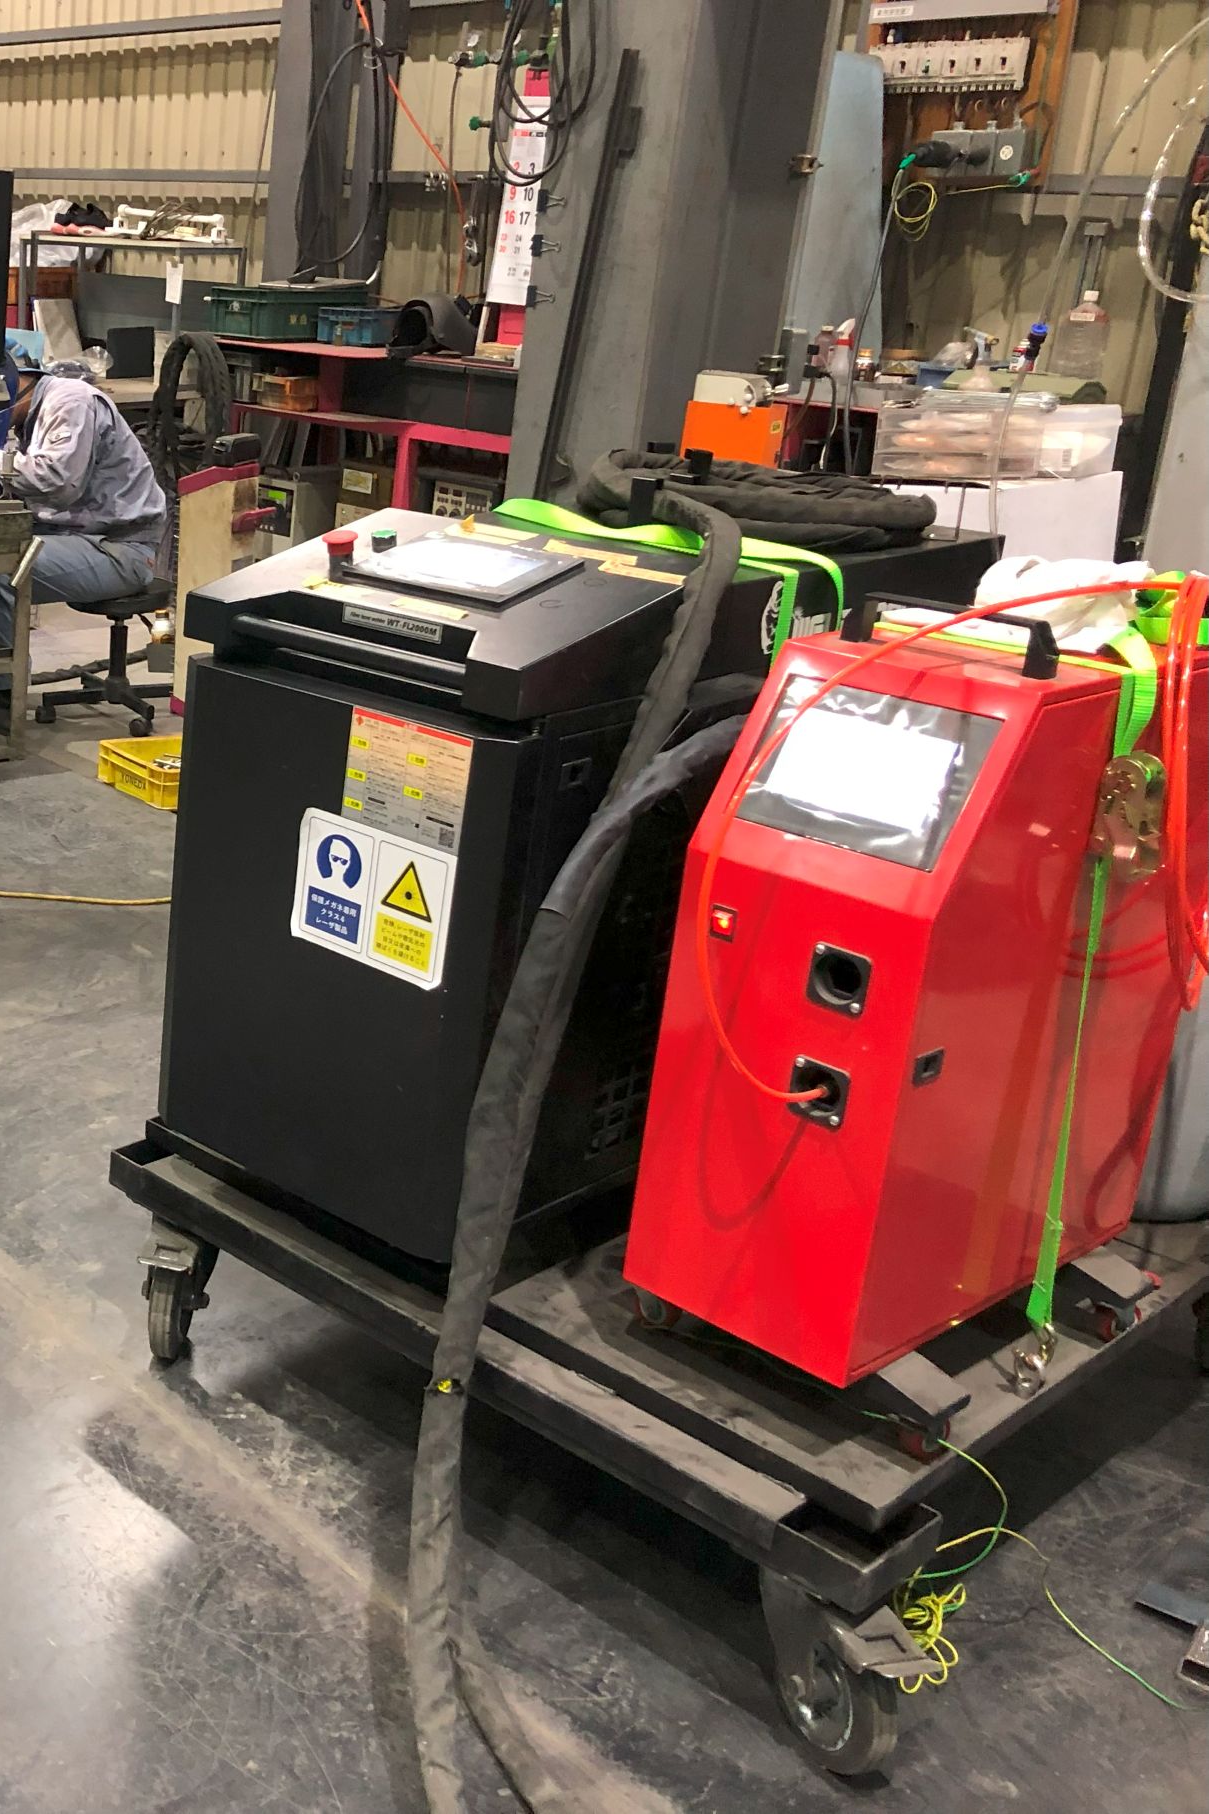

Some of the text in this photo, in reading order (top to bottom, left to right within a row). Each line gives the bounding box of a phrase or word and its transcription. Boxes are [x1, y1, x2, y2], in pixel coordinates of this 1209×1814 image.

[528, 162, 535, 175] 3
[509, 185, 534, 202] 9 10
[504, 209, 531, 226] 16 17
